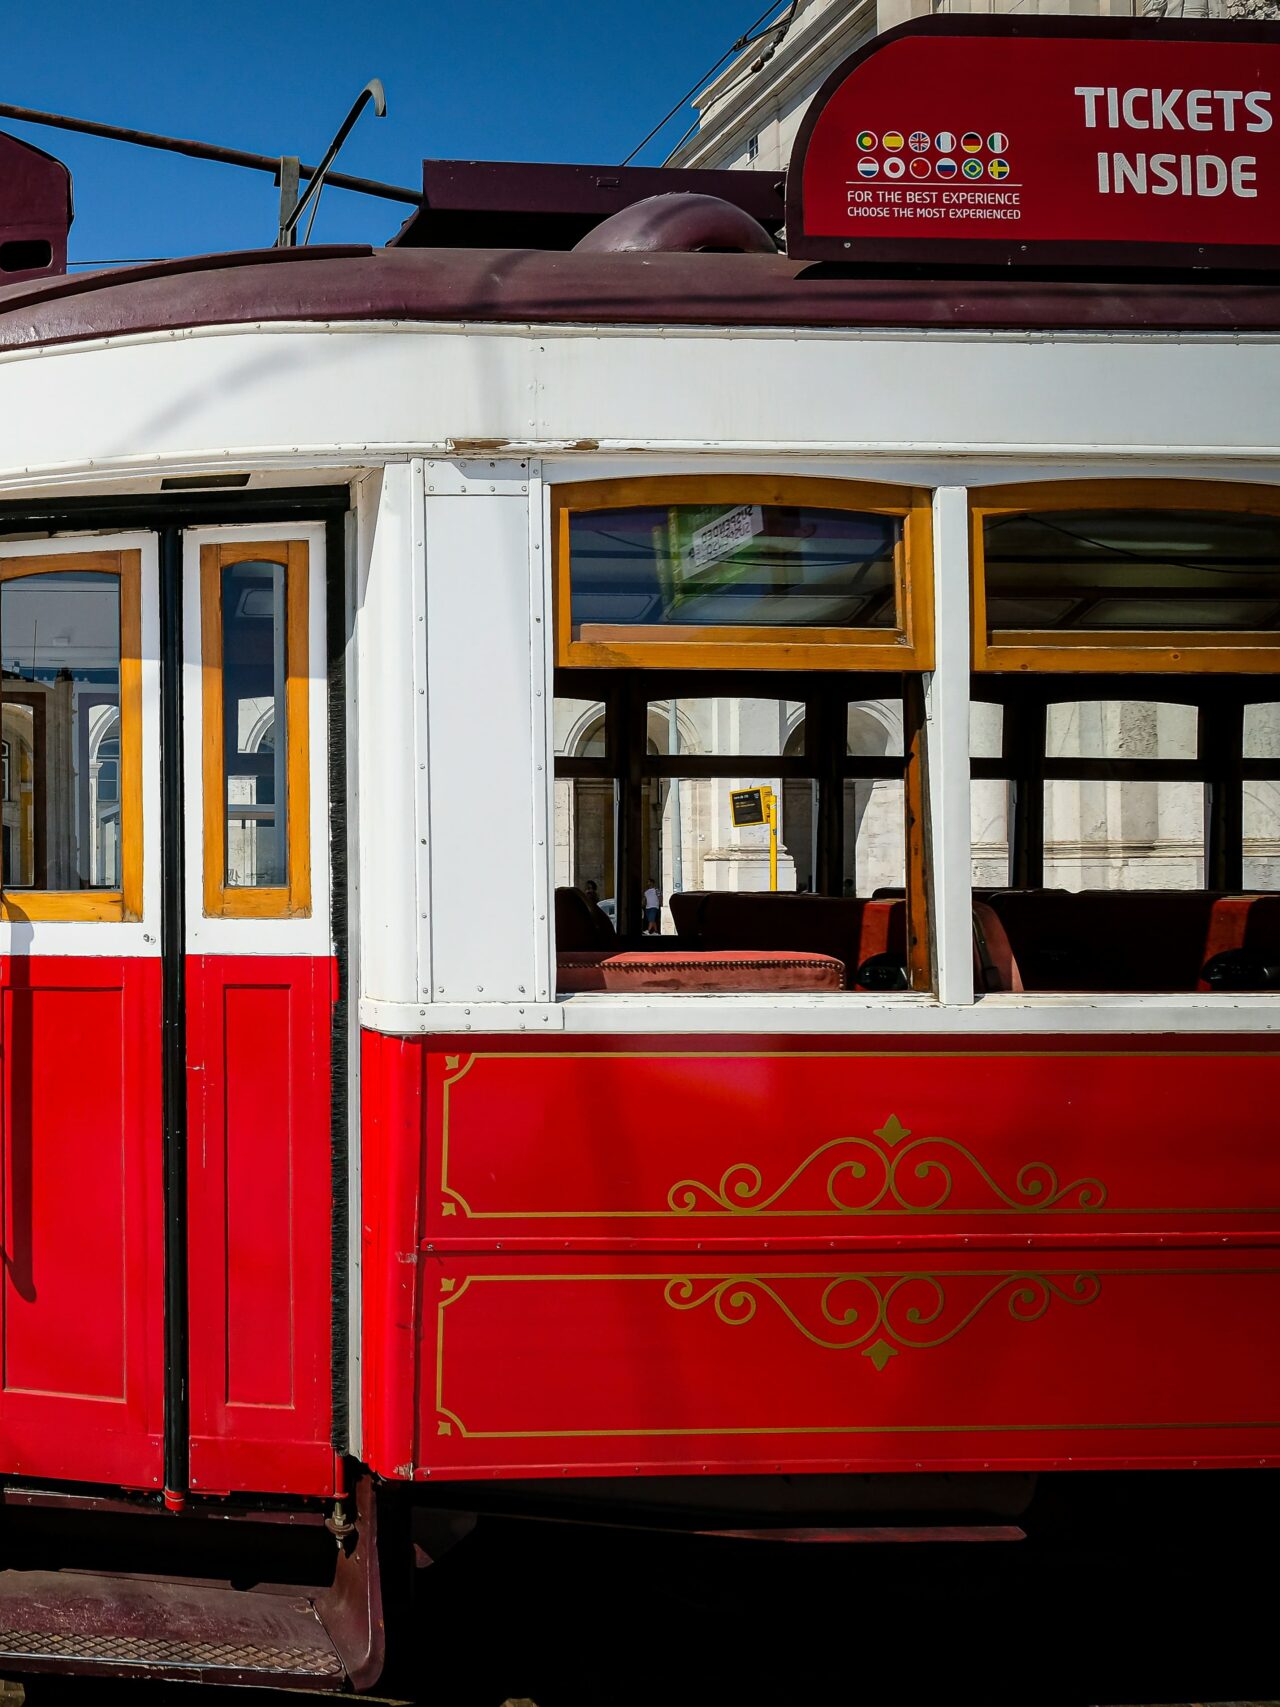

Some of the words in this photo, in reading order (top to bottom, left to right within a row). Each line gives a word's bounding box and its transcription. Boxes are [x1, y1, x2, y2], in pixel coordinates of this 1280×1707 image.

[1074, 86, 1274, 133] TICKETS
[1097, 152, 1258, 198] INSIDE
[847, 190, 873, 203] FOR
[876, 191, 902, 203] THE
[906, 192, 938, 204] BEST
[942, 192, 1020, 205] EXPERIENCE
[847, 206, 890, 218] CHOOSE
[892, 207, 914, 218] THE
[916, 207, 946, 219] MOST
[949, 208, 1021, 220] EXPERIENCED
